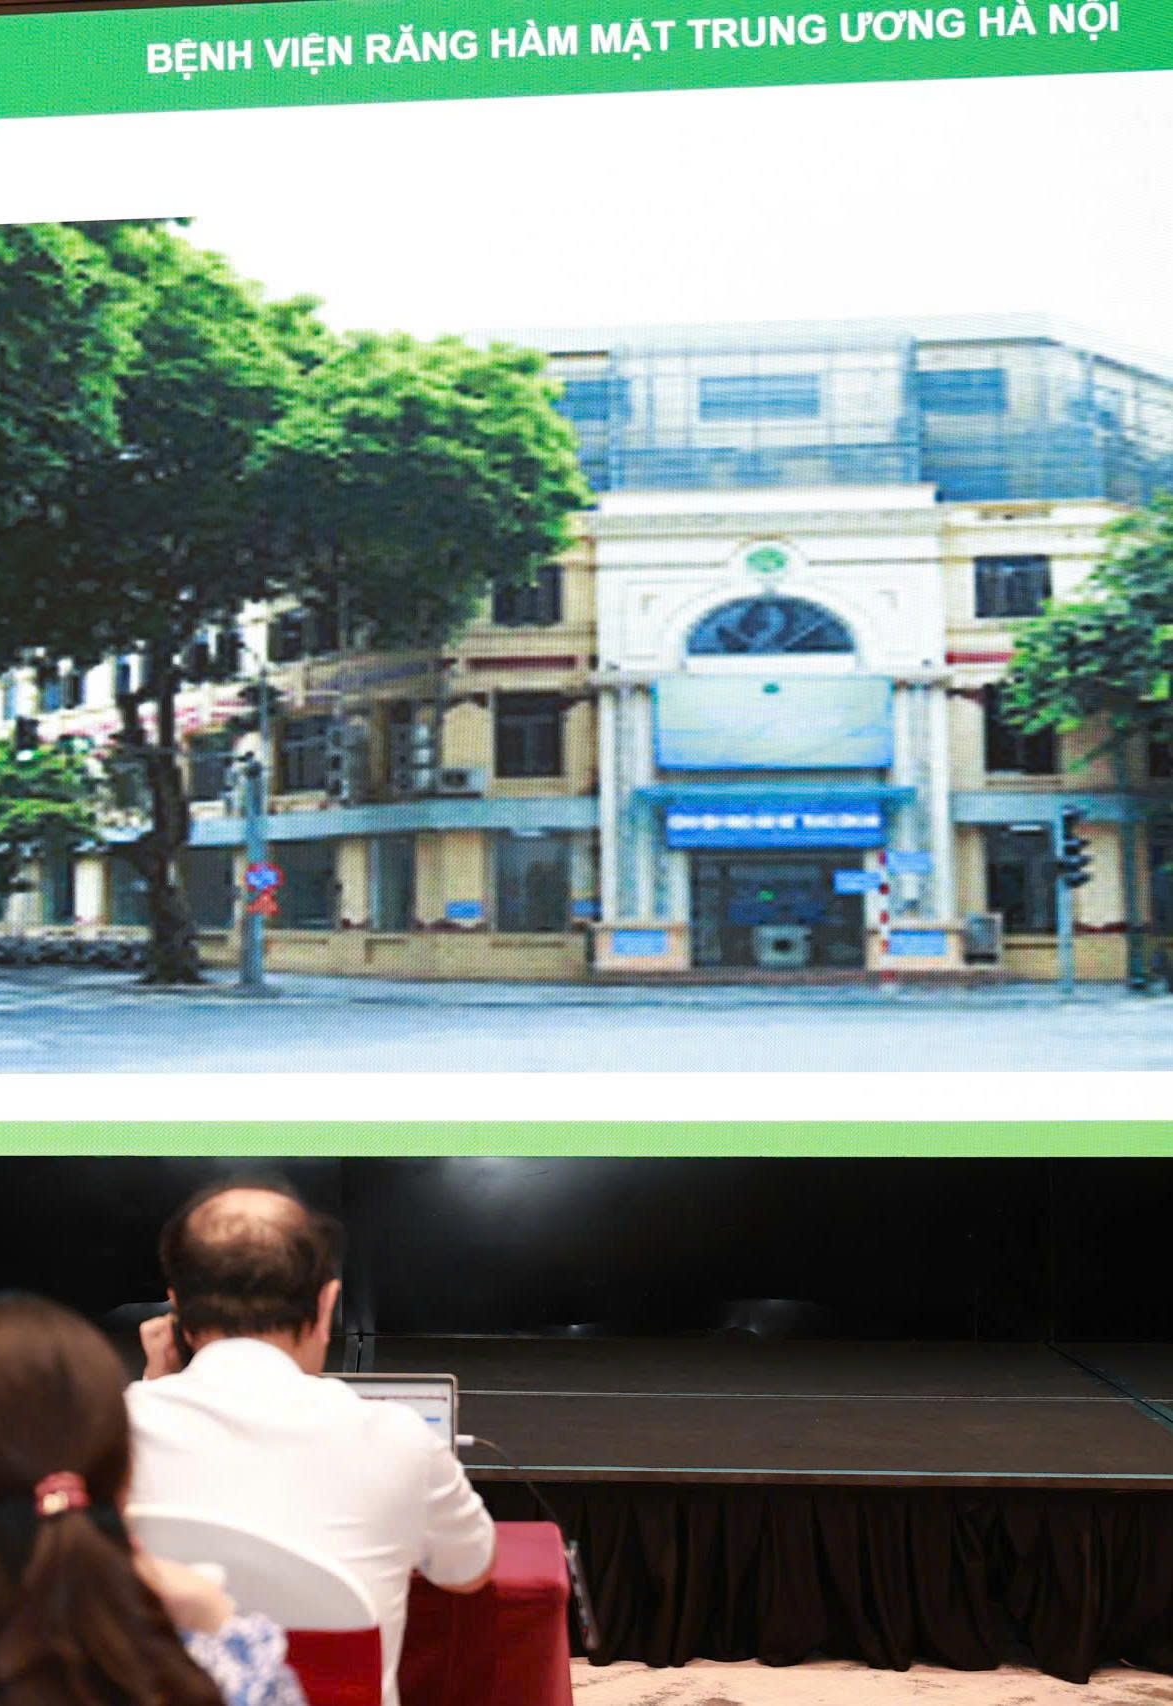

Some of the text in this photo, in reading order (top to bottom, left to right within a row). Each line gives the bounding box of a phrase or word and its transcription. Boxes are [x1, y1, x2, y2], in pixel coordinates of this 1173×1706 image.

[146, 0, 1119, 80] BỆNH VIỆN RĂNG HÀM MẶT TRUNG ƯƠNG HÀ NỘI
